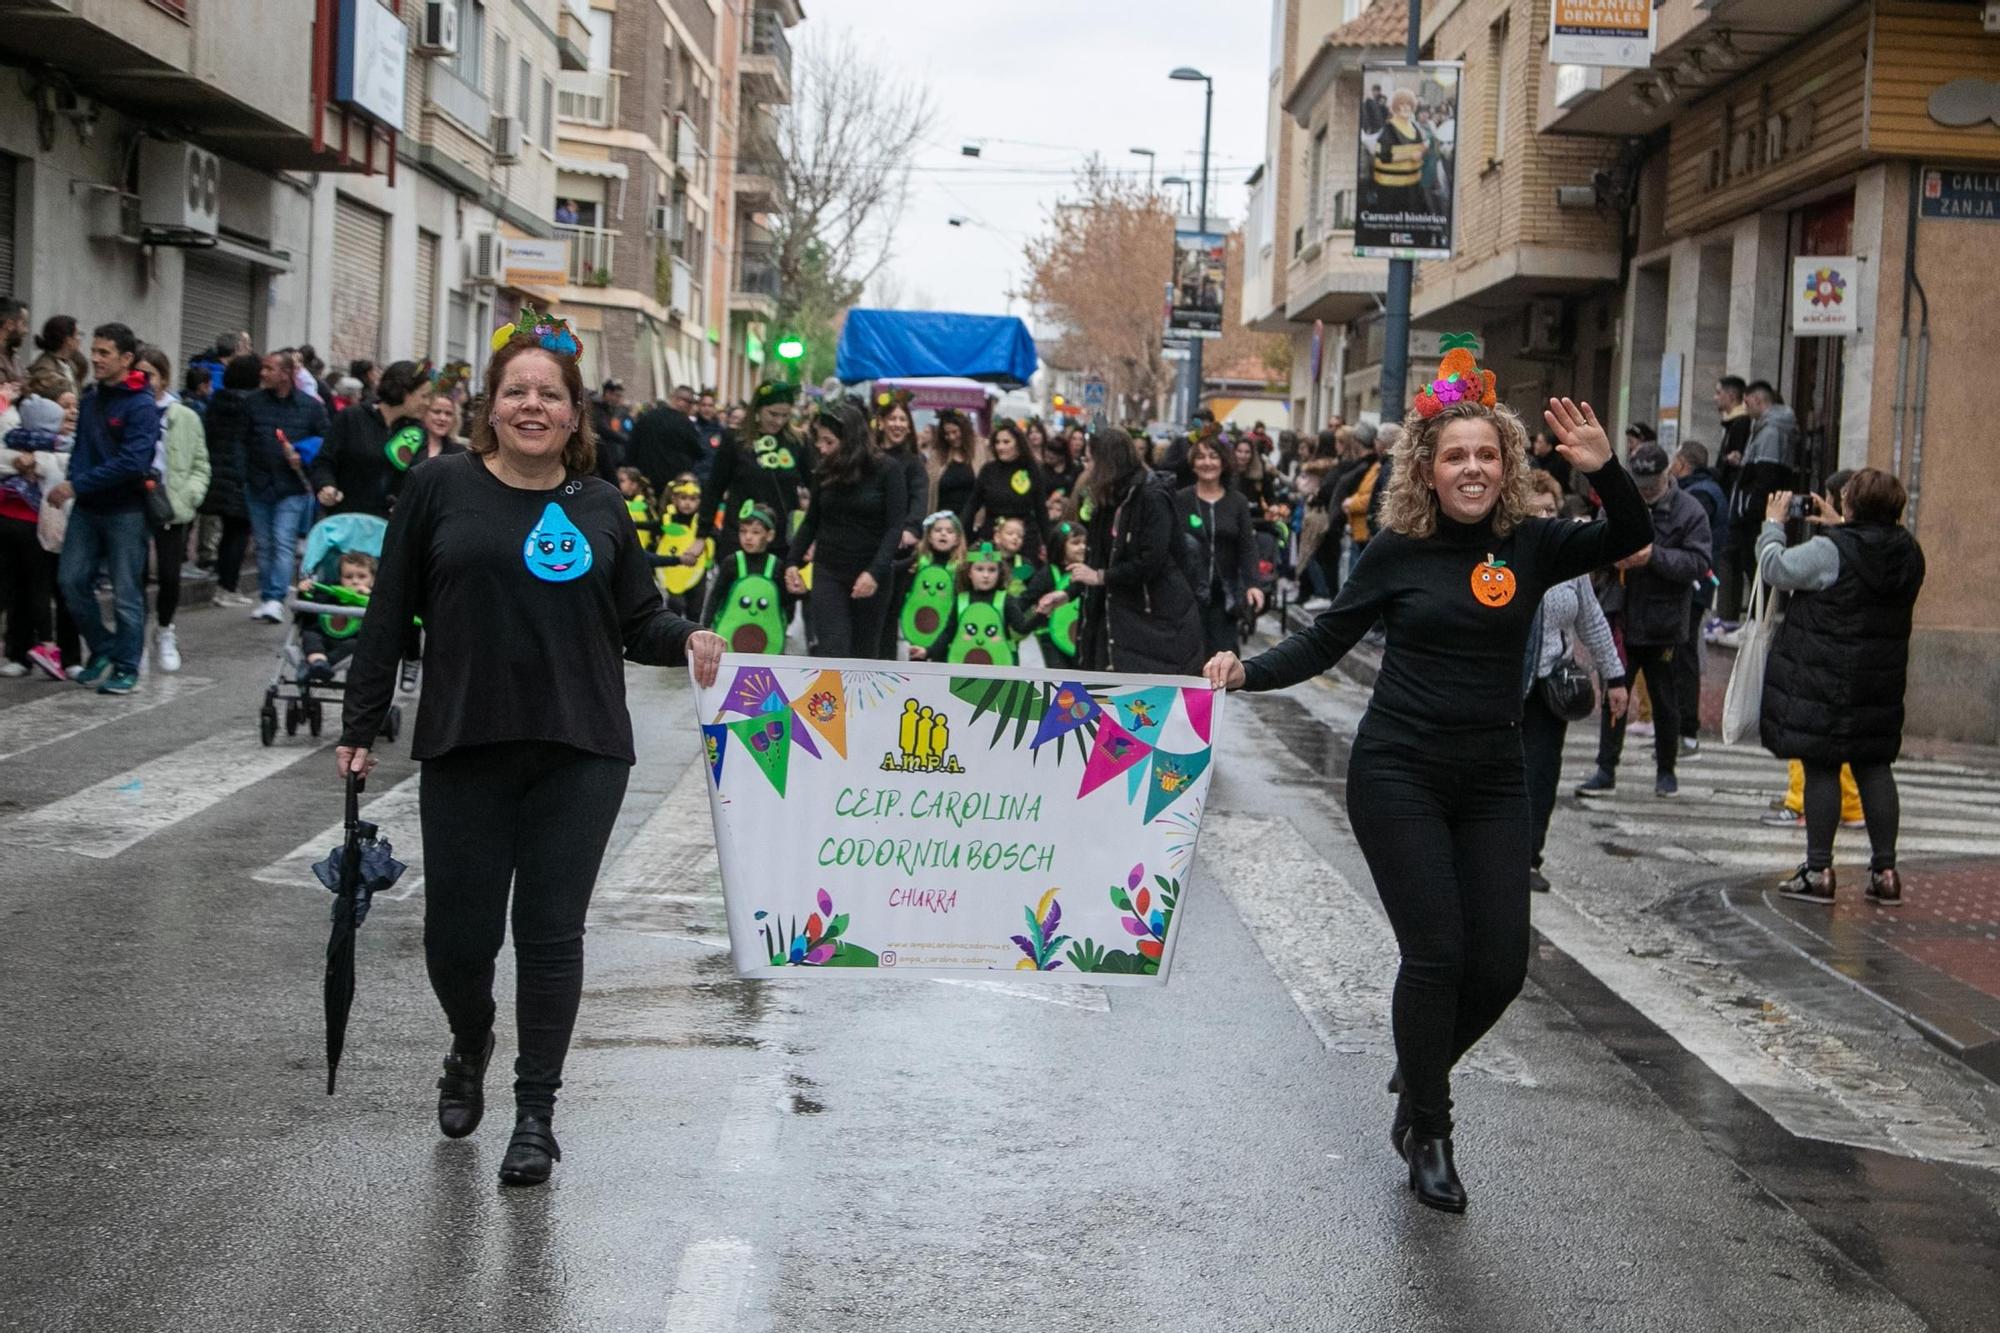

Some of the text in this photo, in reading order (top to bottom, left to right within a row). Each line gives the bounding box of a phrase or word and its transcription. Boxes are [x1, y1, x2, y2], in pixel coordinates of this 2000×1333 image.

[1564, 10, 1641, 24] DENTALES
[1361, 211, 1447, 224] Carnaval histórico
[1941, 199, 1994, 216] ZANJA
[911, 790, 1042, 828] CAROLINA
[818, 838, 1055, 876] CODORNIU BOSCH
[889, 888, 957, 913] CHURRA
